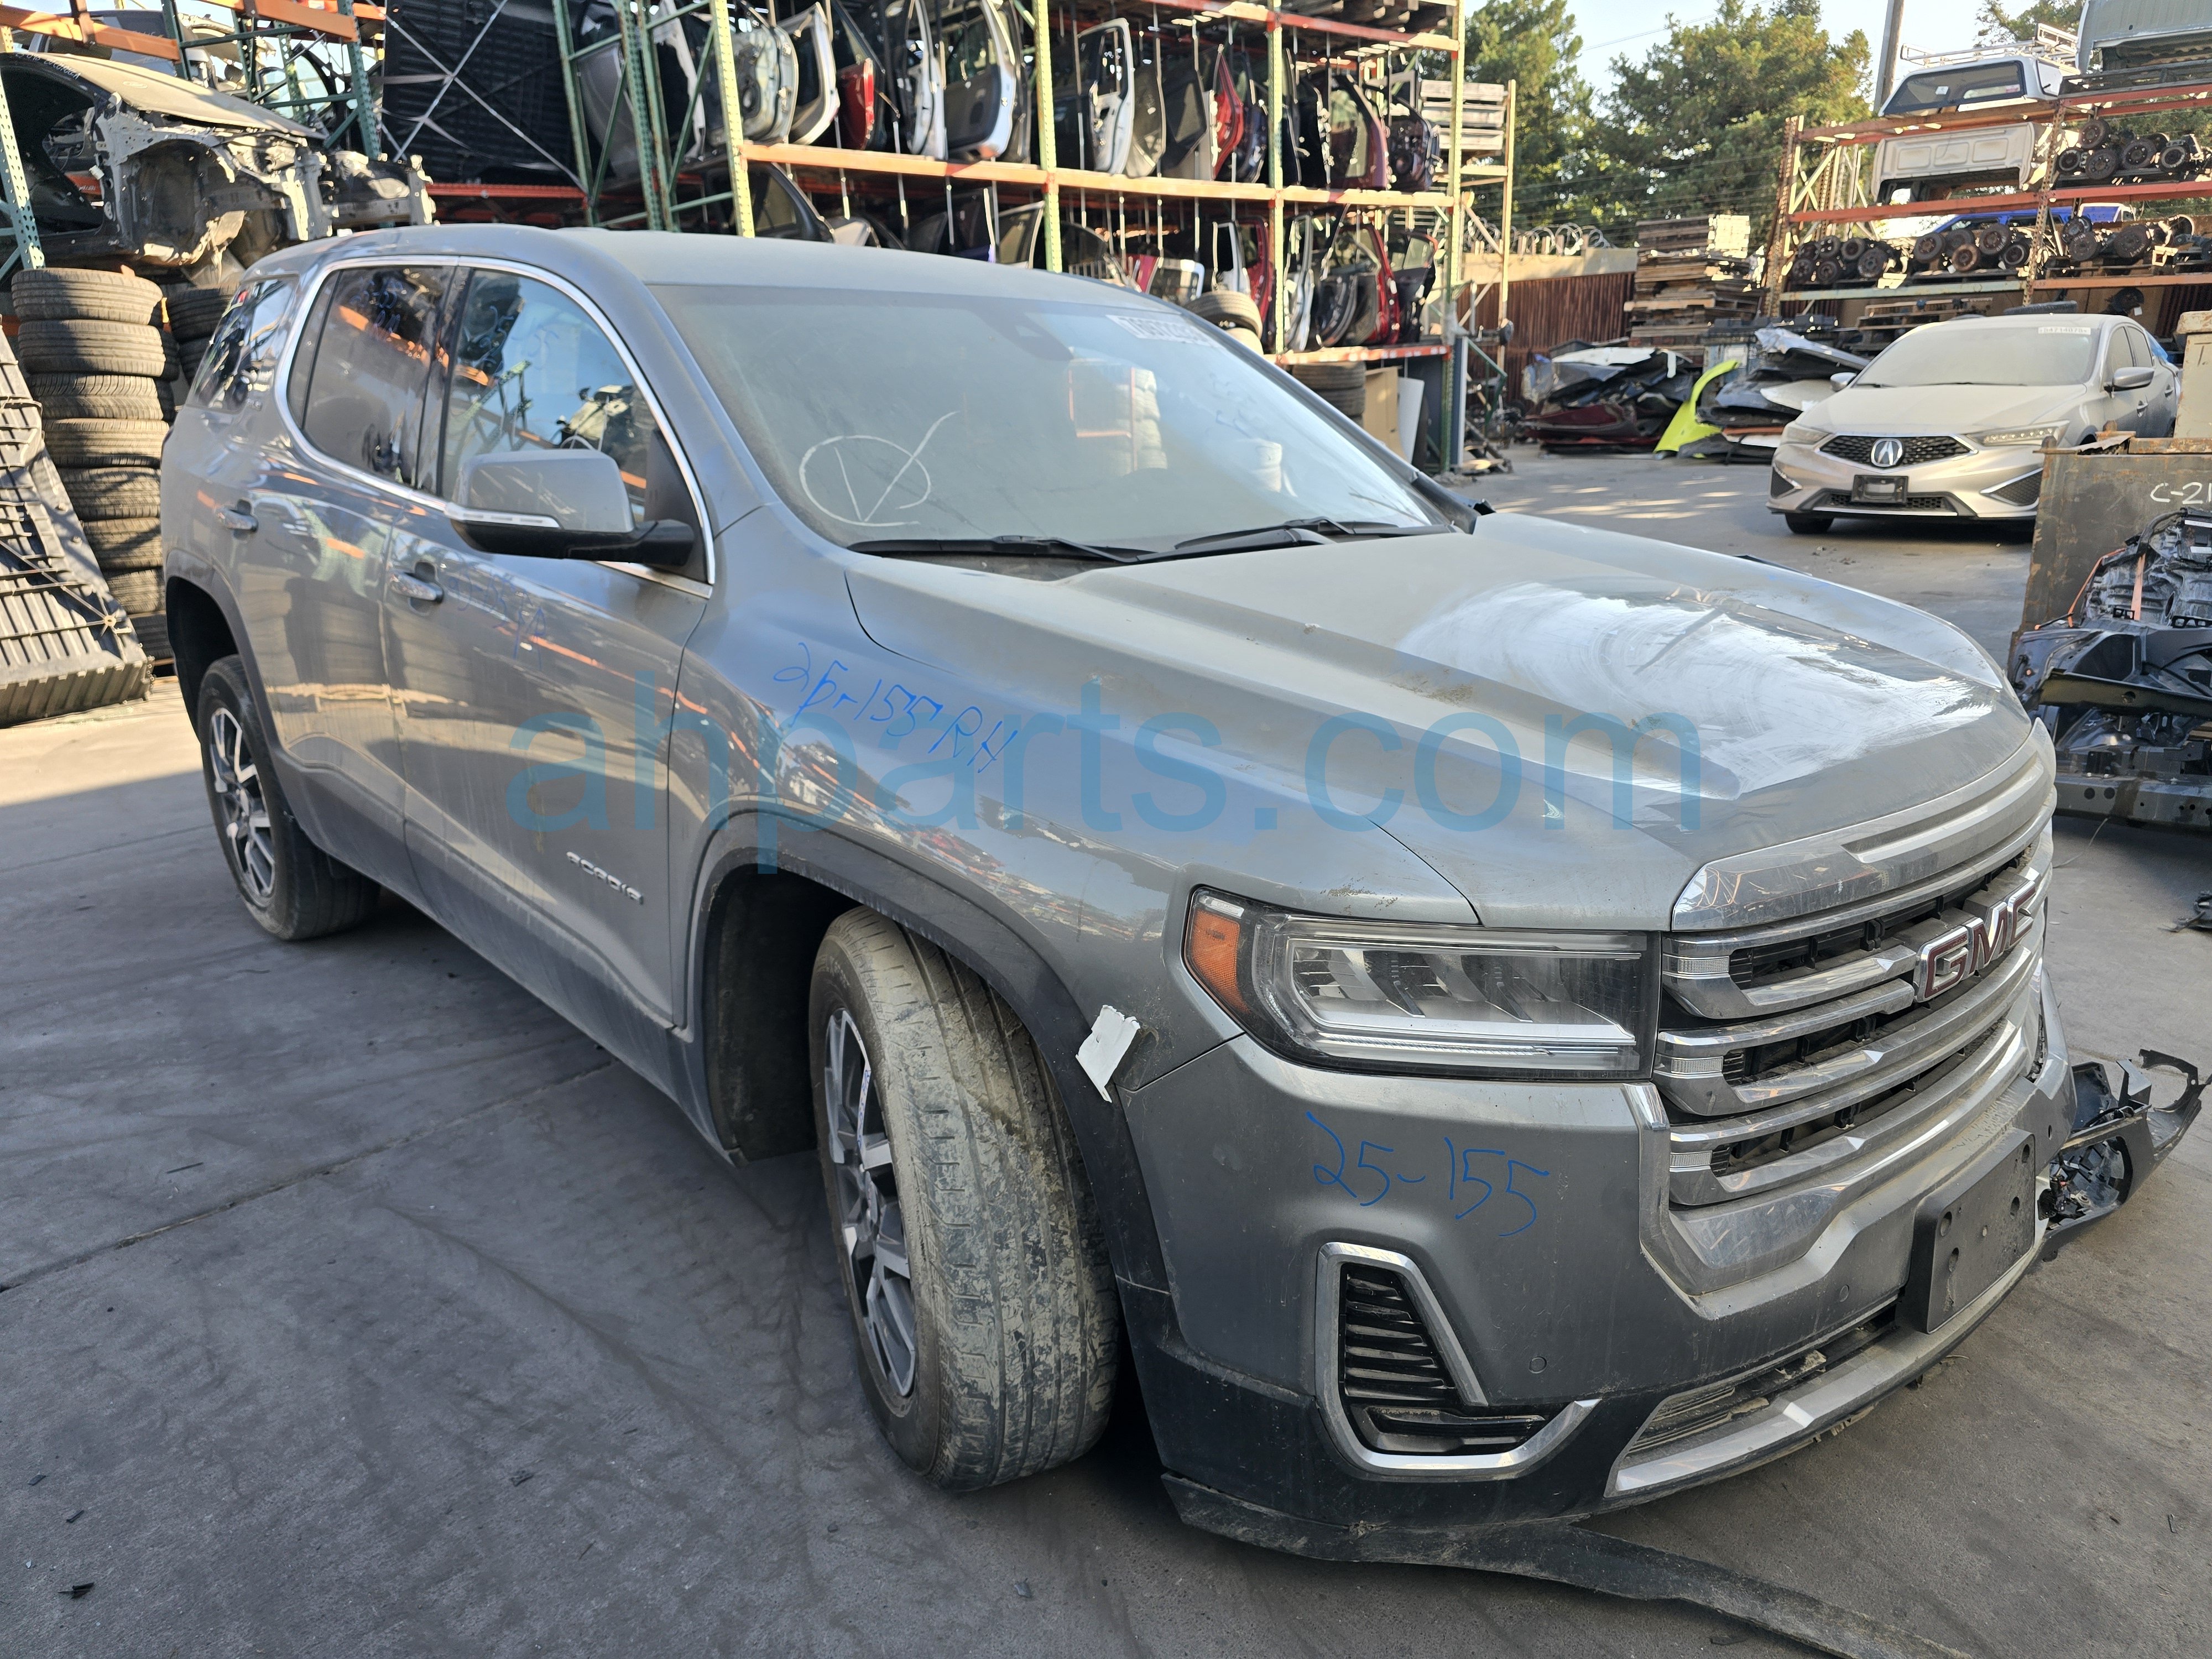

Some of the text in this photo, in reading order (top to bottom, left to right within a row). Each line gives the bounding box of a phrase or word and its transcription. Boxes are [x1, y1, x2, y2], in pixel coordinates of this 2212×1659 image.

[566, 851, 643, 905] ACADIA
[1912, 880, 2036, 1003] GMC
[1305, 1110, 1550, 1237] 25-155
